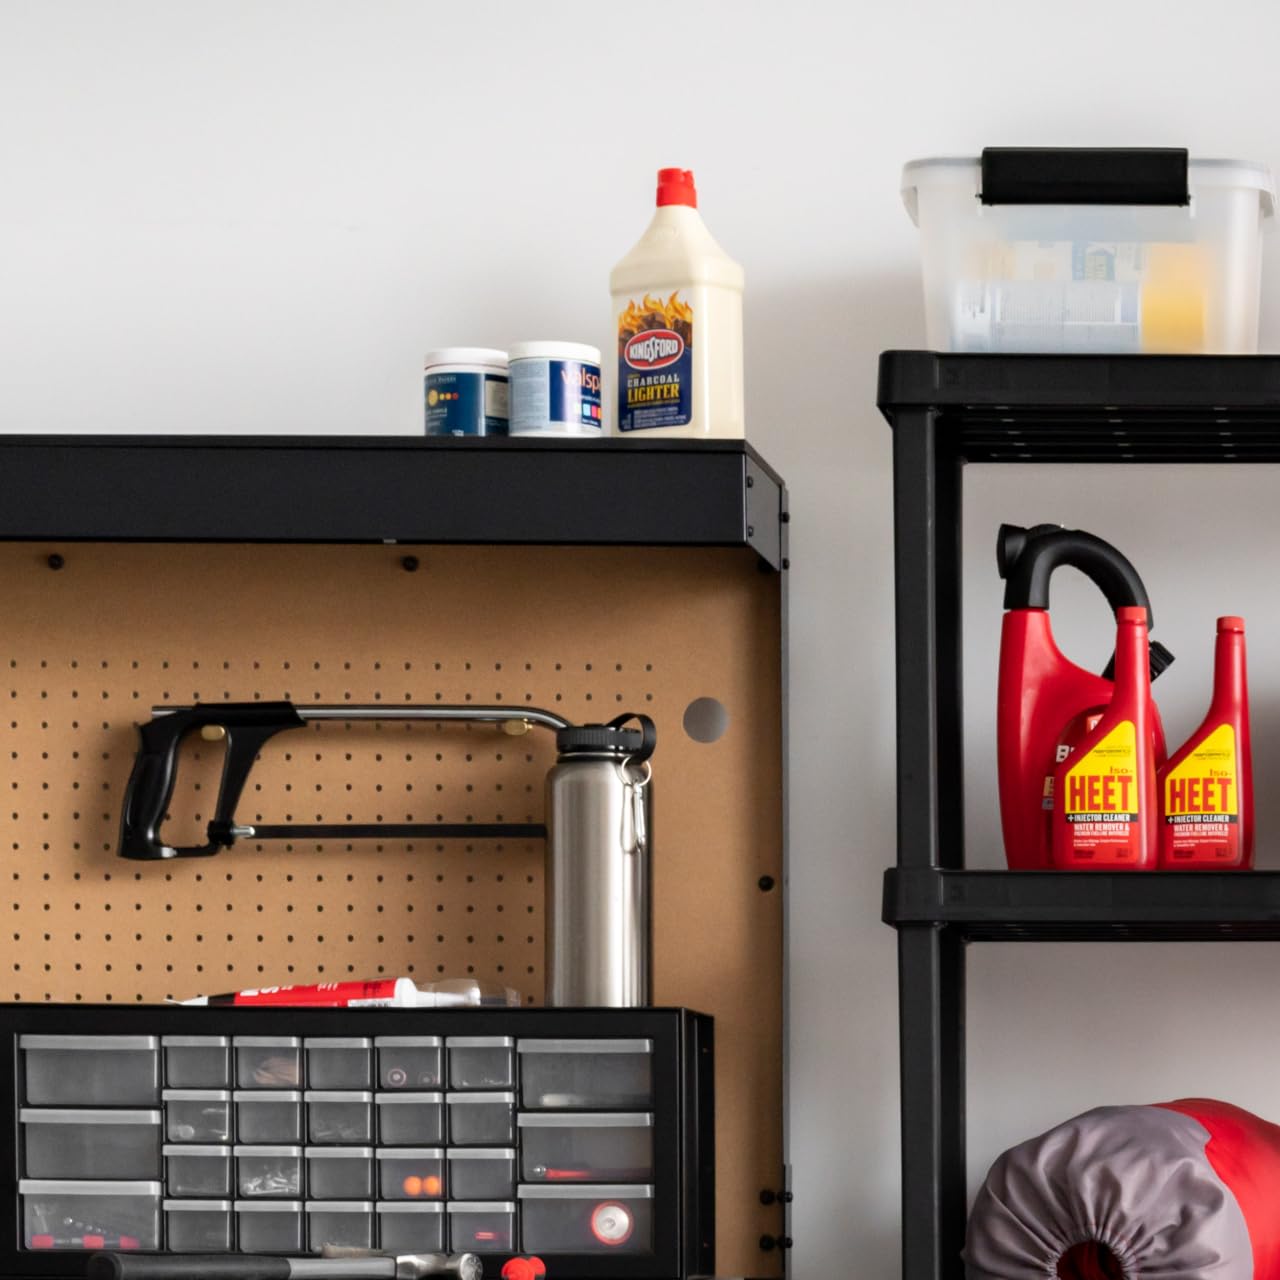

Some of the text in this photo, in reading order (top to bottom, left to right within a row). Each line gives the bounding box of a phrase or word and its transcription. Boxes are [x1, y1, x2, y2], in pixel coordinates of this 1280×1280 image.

[630, 336, 678, 363] KINGSFORD
[627, 373, 680, 388] CHARCOAL
[627, 384, 680, 403] LIGHTER
[1070, 775, 1133, 811] HEET
[1170, 778, 1232, 812] HEET
[1103, 813, 1130, 822] CLEANER
[1202, 814, 1230, 823] CLEANER
